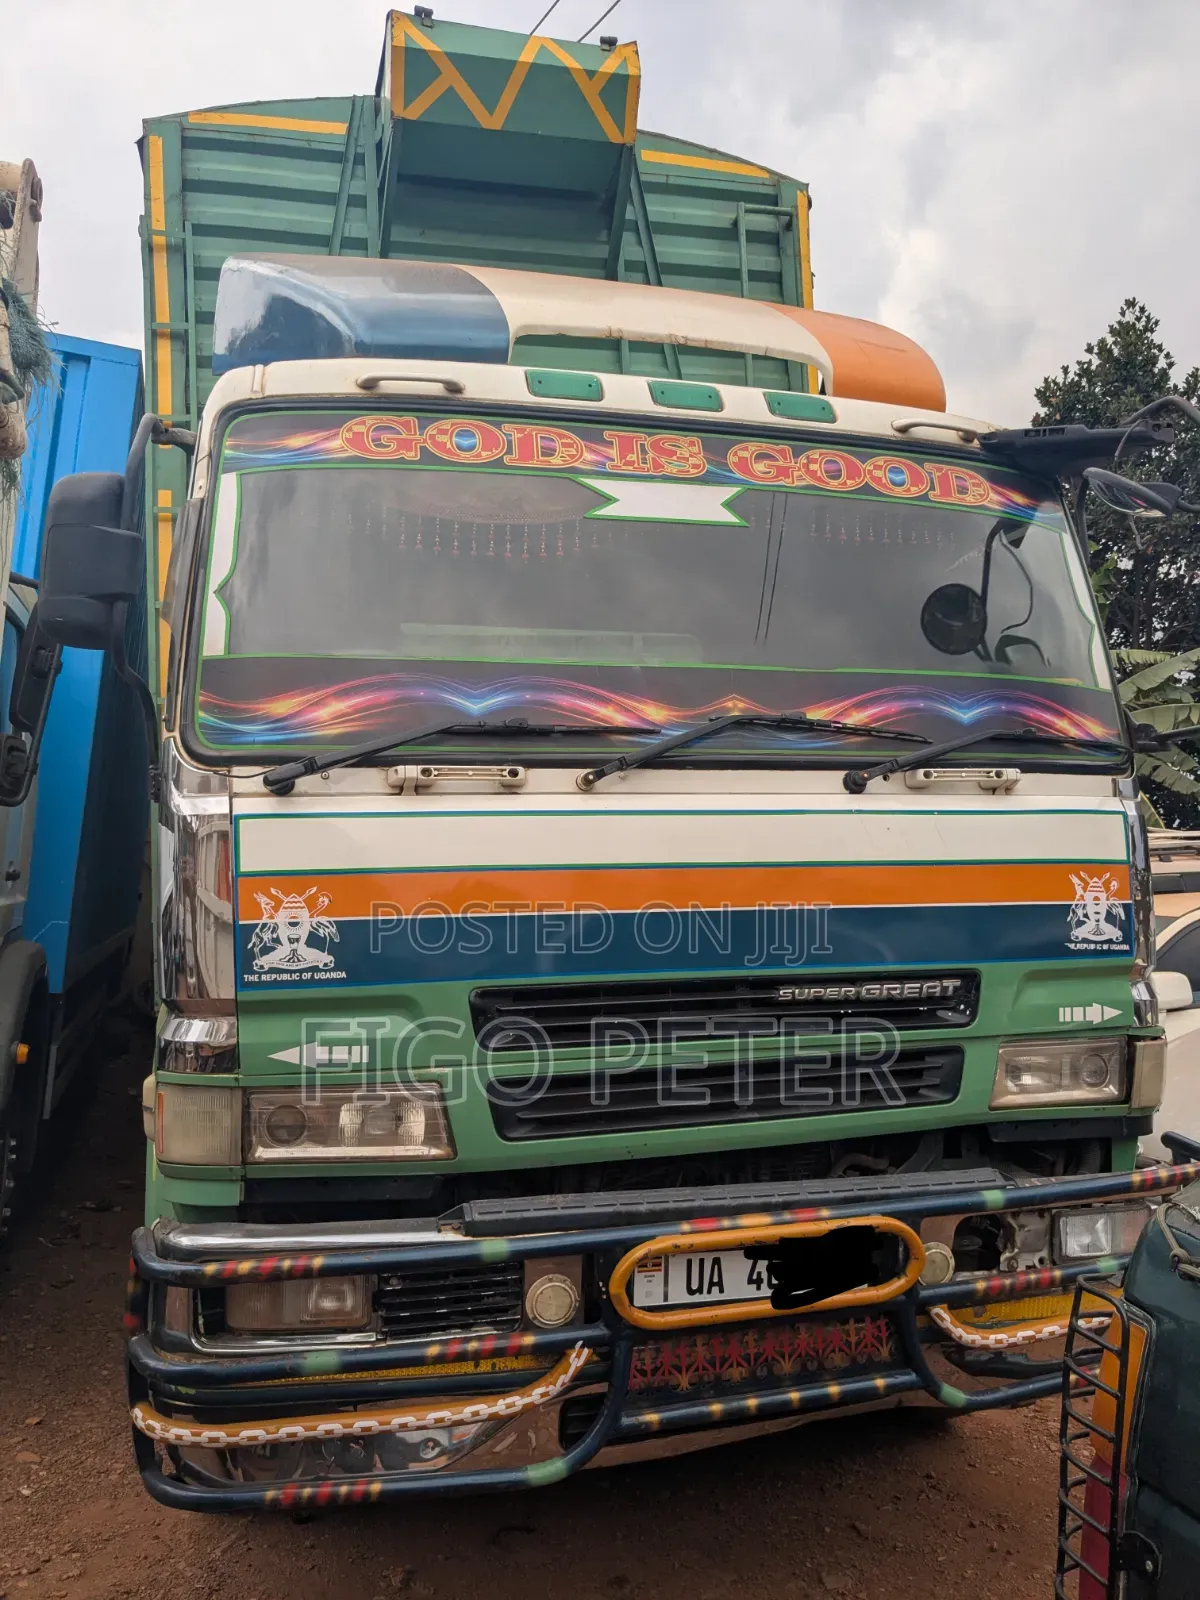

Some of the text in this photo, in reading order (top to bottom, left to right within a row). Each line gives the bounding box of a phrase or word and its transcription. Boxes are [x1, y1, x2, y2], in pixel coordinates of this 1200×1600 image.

[340, 415, 992, 506] GOD IS GOOD
[243, 971, 347, 982] THE REPUBLIC OF UGANDA
[778, 979, 962, 1001] SUPER GREAT
[685, 1256, 725, 1296] UA
